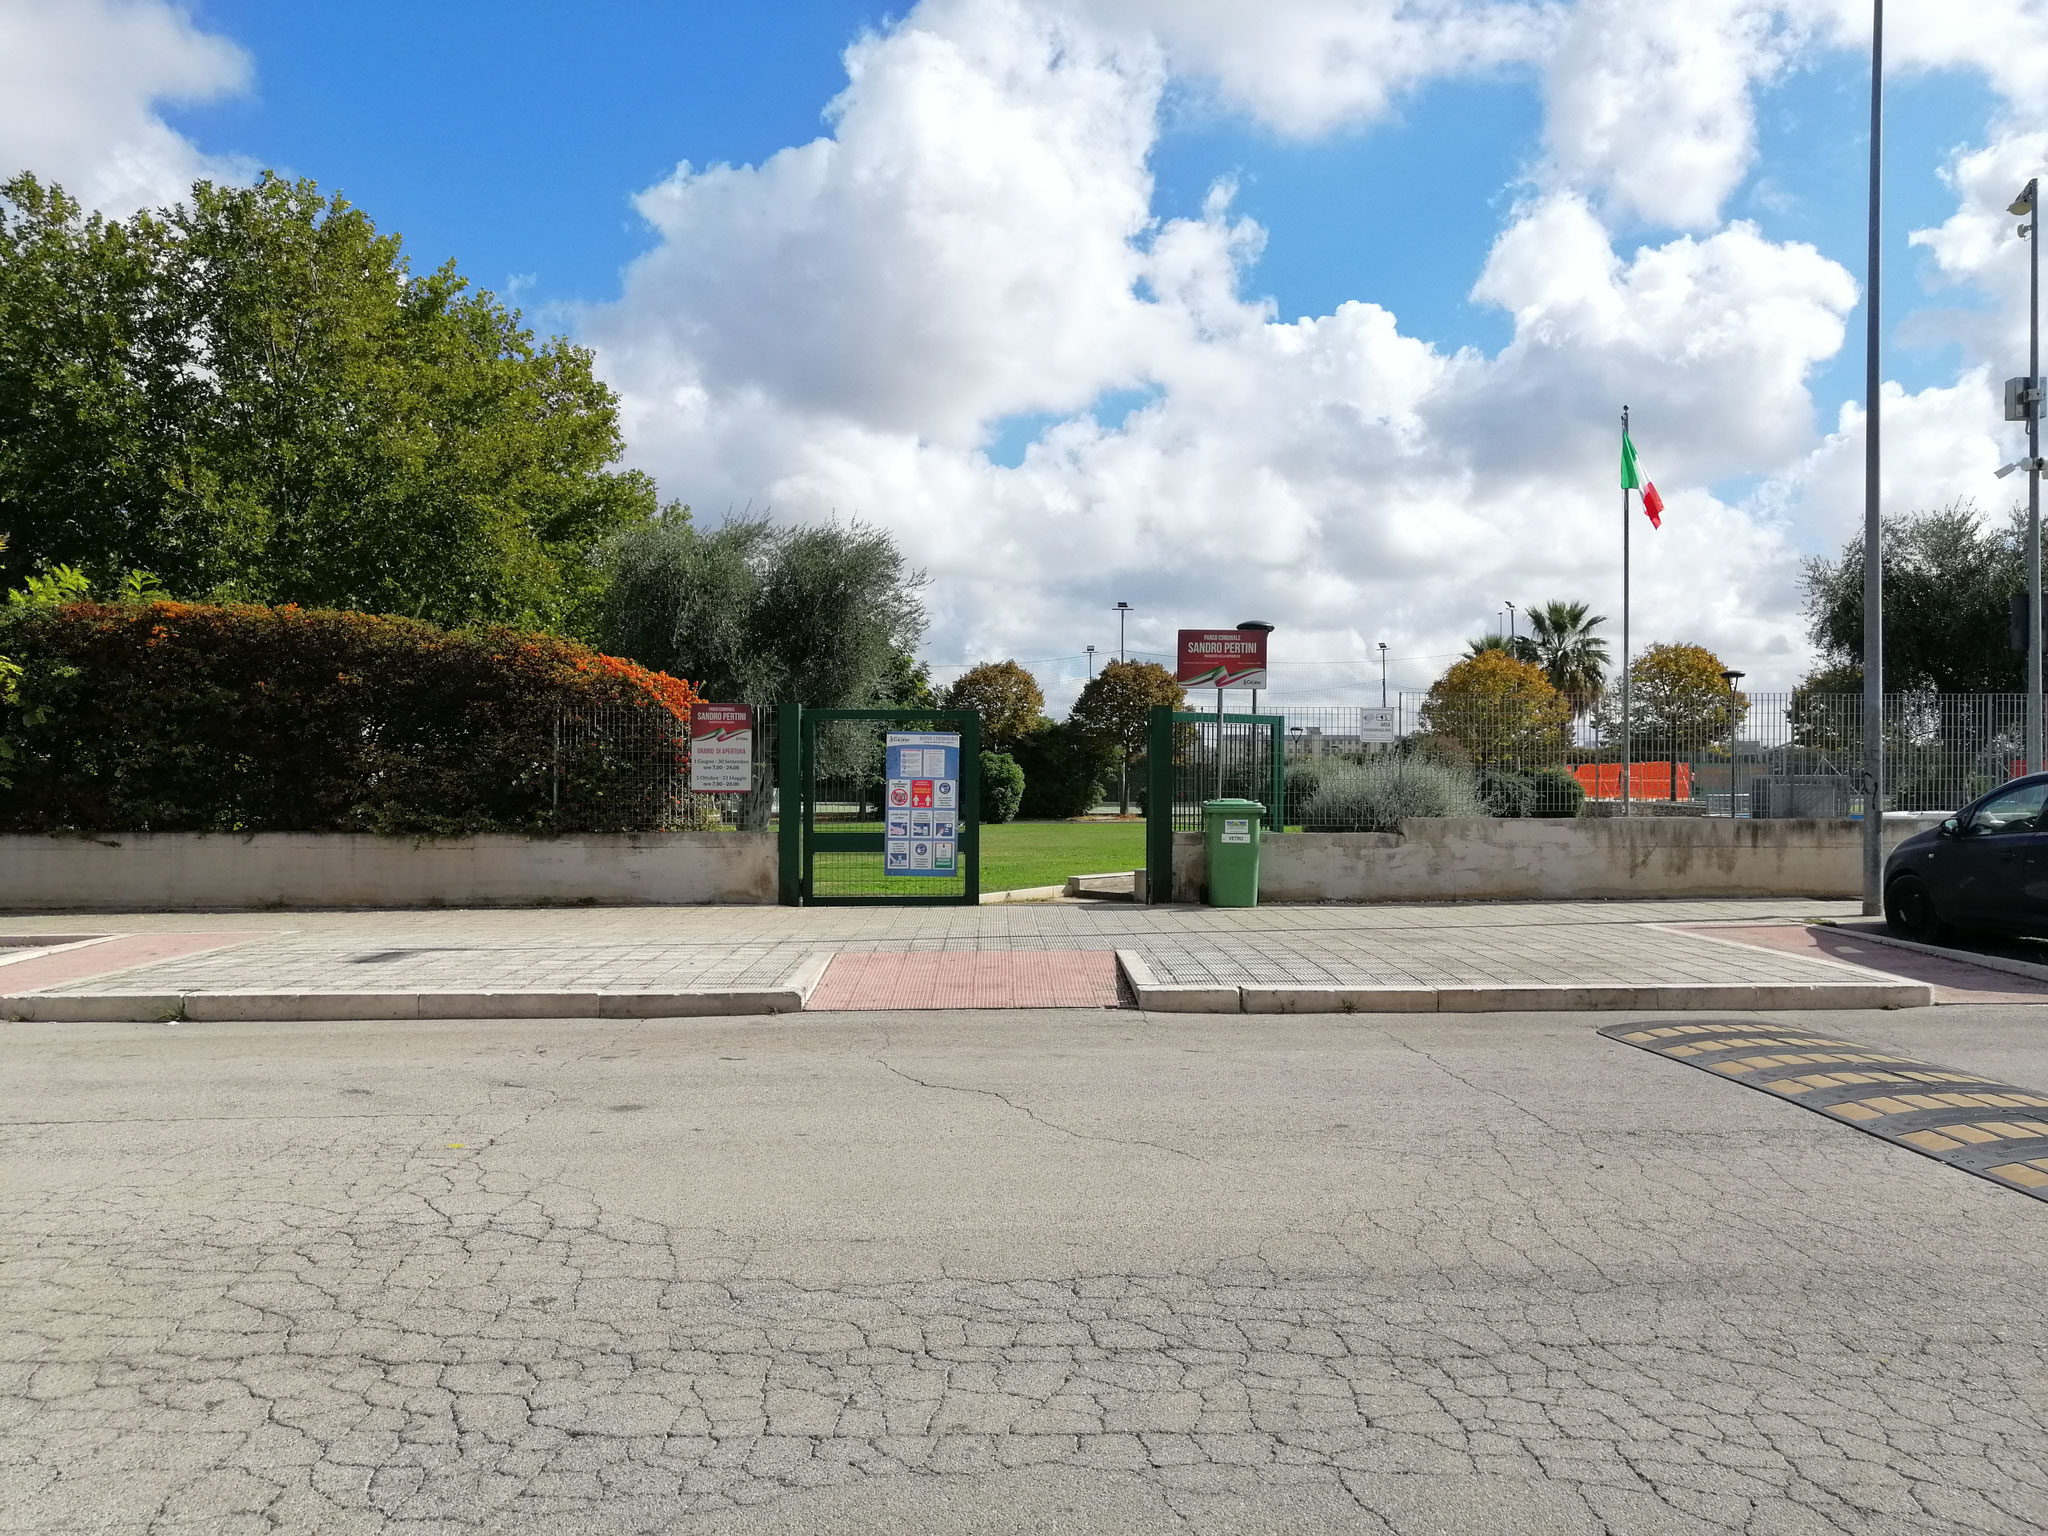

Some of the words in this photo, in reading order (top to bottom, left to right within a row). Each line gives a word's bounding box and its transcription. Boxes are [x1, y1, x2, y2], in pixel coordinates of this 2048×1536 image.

[1188, 642, 1222, 653] SANDRO
[1224, 642, 1257, 653] PERTINI
[697, 712, 721, 720] SANDRO
[723, 712, 746, 720] PERTINI
